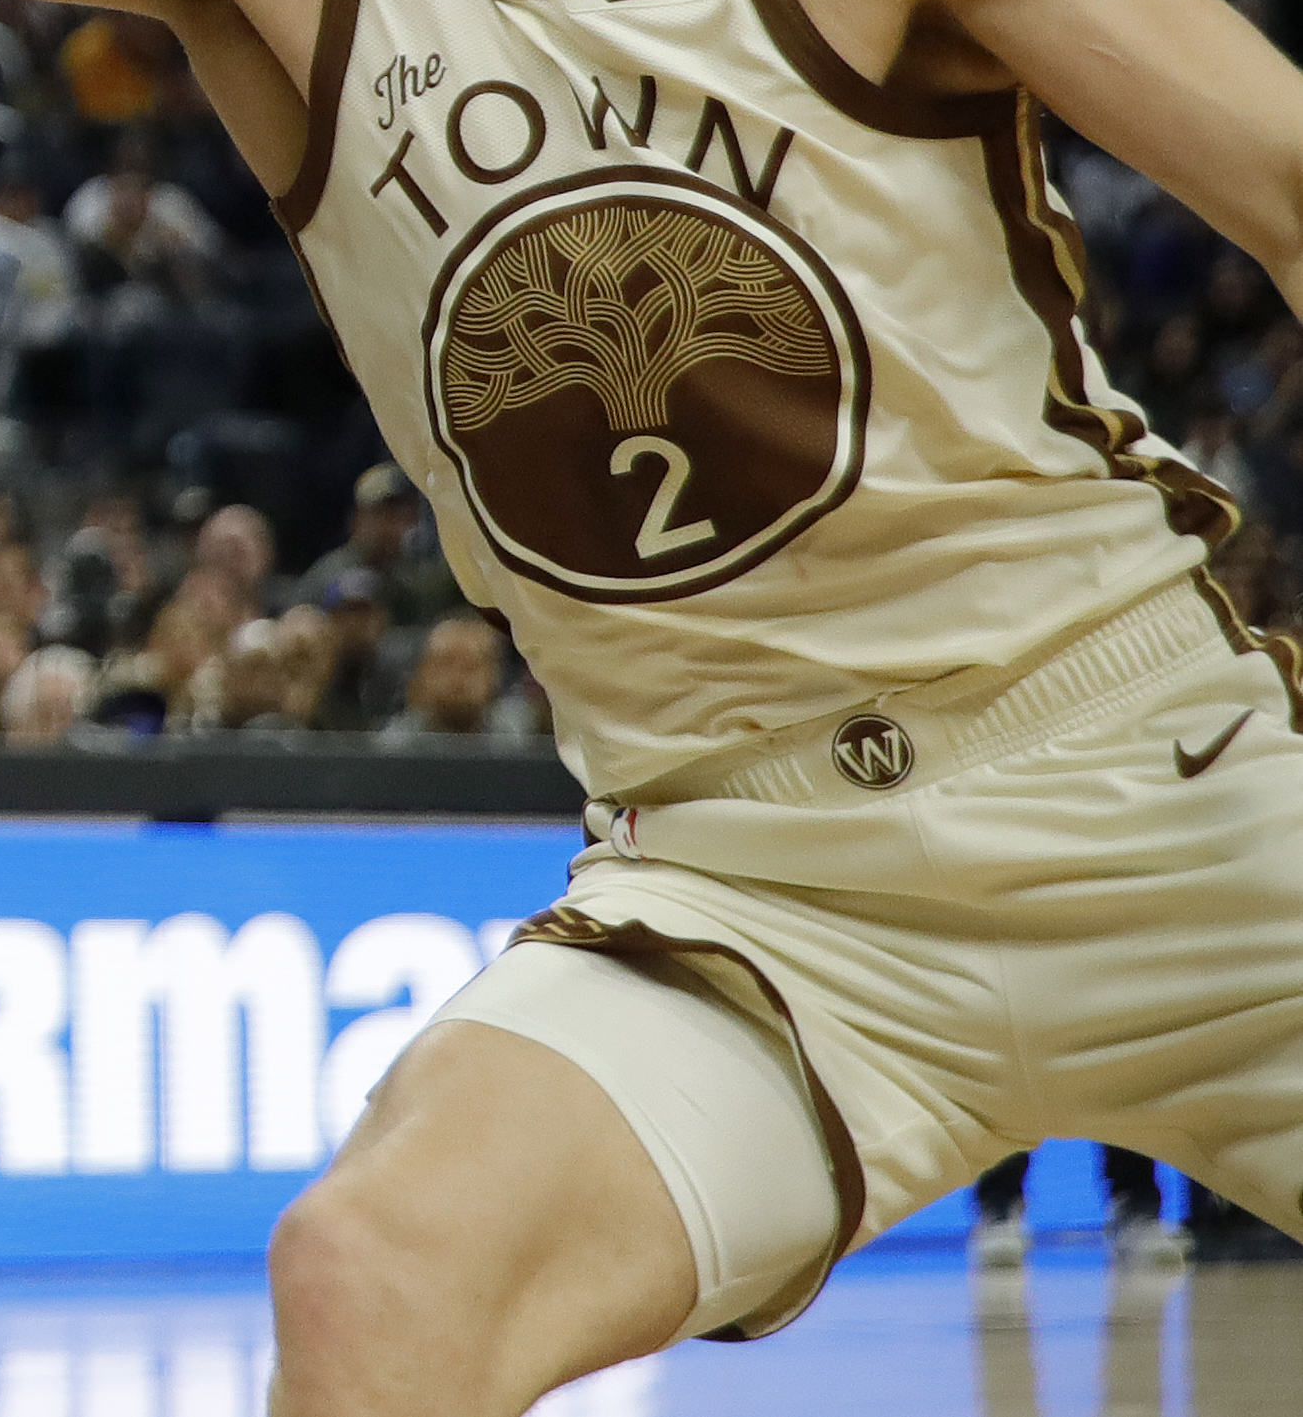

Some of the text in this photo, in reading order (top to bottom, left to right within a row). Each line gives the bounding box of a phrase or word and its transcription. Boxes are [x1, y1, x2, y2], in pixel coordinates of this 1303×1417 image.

[373, 51, 448, 132] The
[369, 75, 796, 239] TOWN
[609, 435, 717, 561] 2
[837, 726, 904, 784] W
